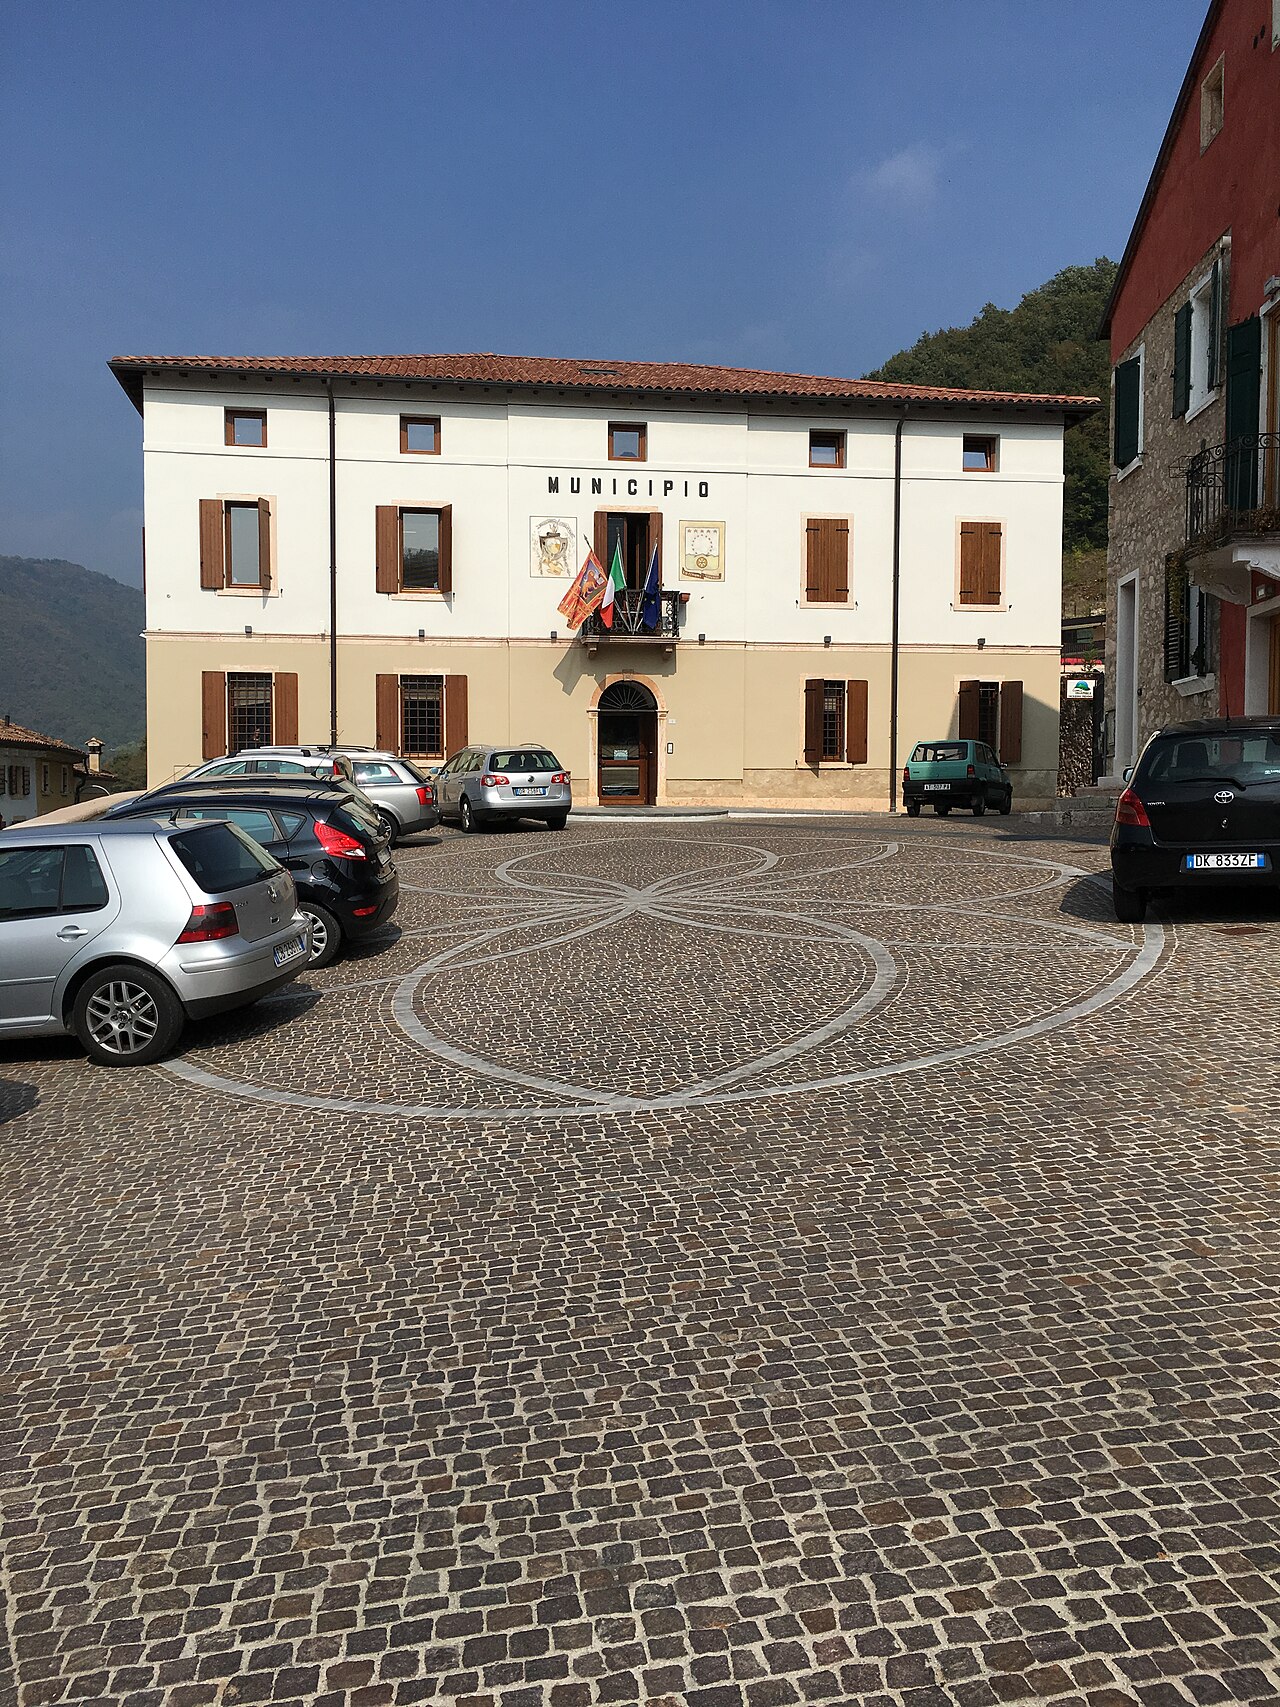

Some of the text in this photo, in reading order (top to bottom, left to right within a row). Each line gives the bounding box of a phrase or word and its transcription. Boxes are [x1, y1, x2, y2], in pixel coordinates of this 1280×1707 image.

[548, 476, 709, 497] MUNICIPIO
[1196, 854, 1256, 866] DK 833ZF
